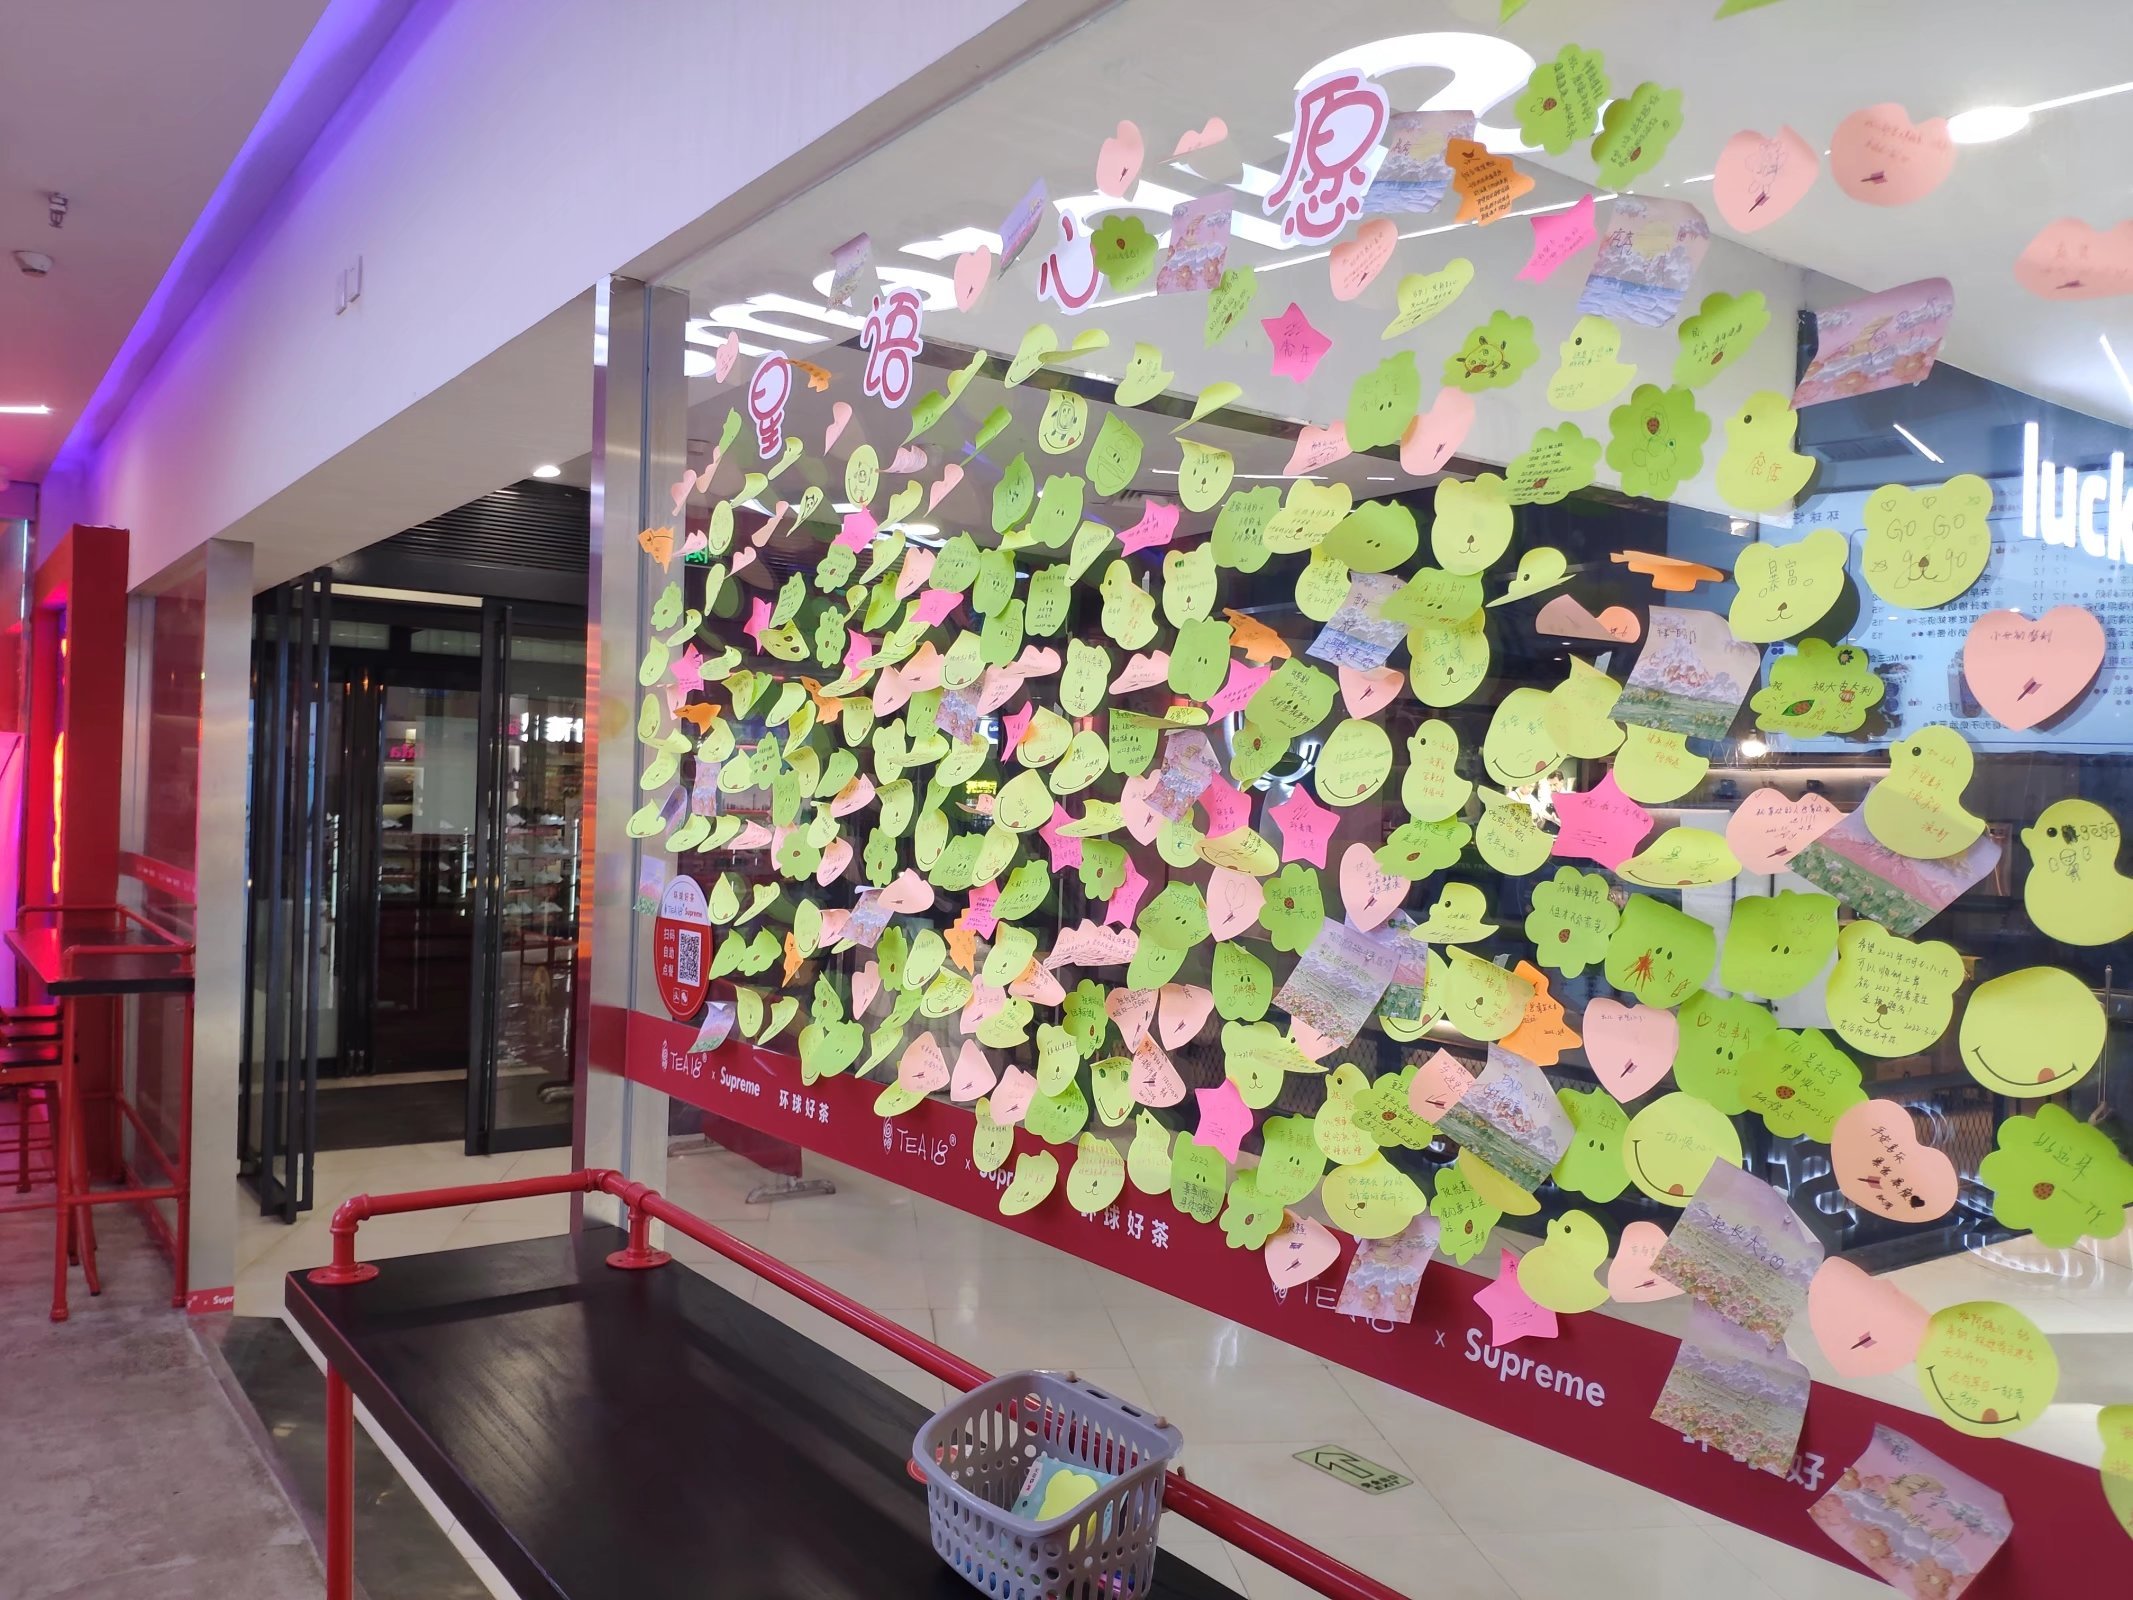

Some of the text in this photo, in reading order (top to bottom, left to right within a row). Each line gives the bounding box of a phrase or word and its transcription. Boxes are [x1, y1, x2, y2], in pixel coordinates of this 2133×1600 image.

[663, 945, 675, 960] 自助
[720, 1066, 761, 1097] Supreme
[779, 1089, 830, 1124] 环球好茶
[979, 1170, 1015, 1190] Supr
[1464, 1327, 1606, 1408] Supreme
